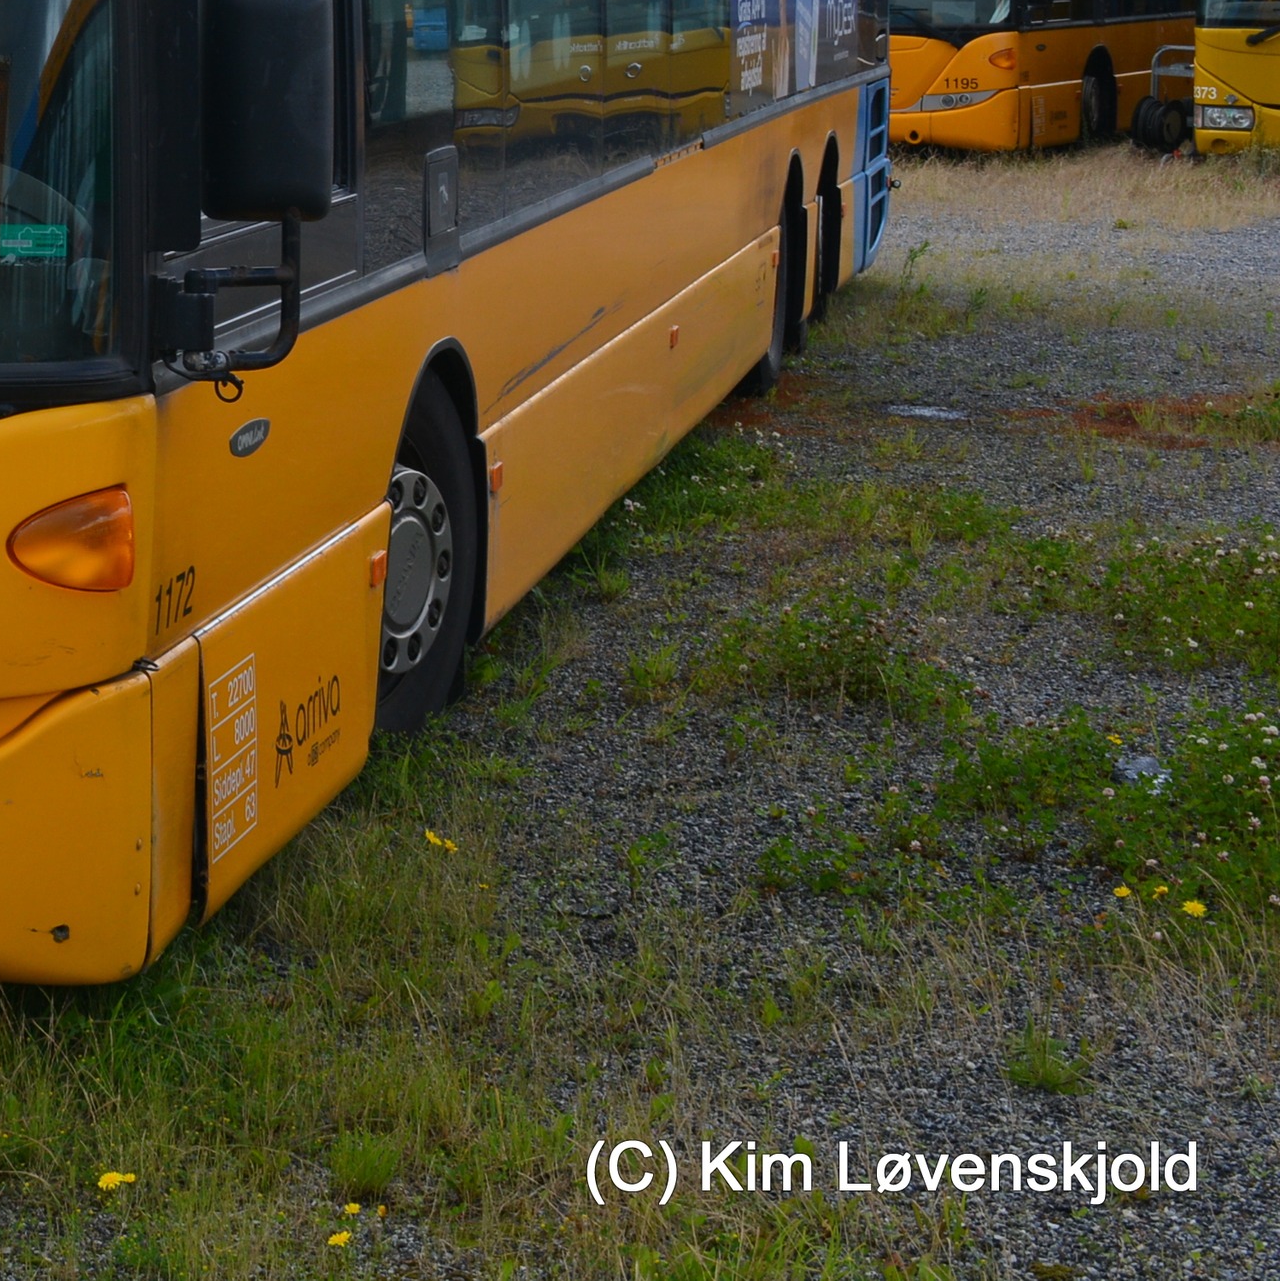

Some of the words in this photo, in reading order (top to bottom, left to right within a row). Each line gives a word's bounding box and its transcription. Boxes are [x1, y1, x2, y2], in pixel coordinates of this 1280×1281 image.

[944, 78, 979, 90] 1195
[155, 565, 196, 636] 1172
[227, 666, 254, 709] 22700
[234, 707, 255, 745] 8000
[295, 674, 341, 747] arriva
[244, 751, 256, 779] 47
[244, 791, 256, 823] 63
